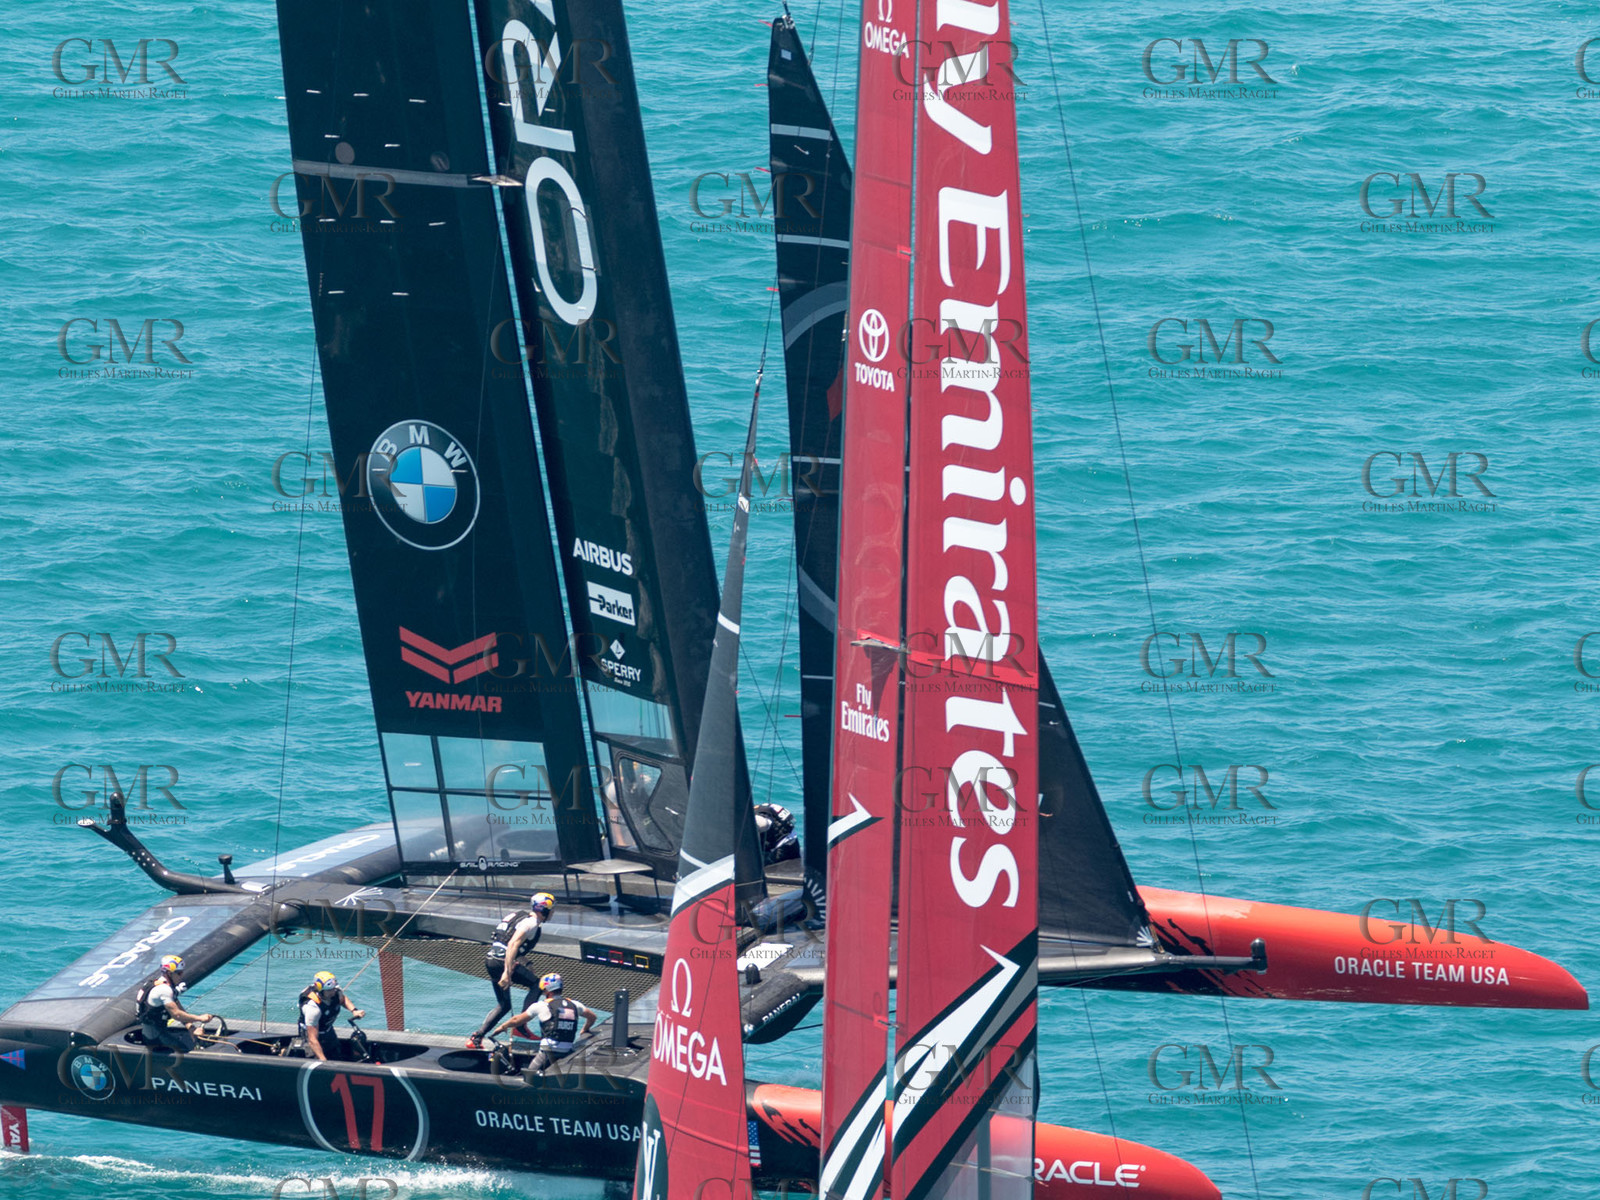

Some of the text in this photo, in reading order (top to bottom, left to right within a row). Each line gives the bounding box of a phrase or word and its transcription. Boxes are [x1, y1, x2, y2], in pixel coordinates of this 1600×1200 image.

[864, 21, 909, 58] OMEGA
[854, 362, 895, 392] TOYOTA
[376, 424, 468, 469] BMW
[573, 537, 633, 576] AIRBUS
[938, 186, 1028, 908] Emirates
[597, 594, 633, 621] Parker
[601, 658, 642, 682] SPERRY
[405, 691, 502, 713] YANMAR
[856, 683, 872, 710] Fly
[841, 700, 890, 742] Emirates
[78, 916, 191, 988] ORACLE
[1334, 956, 1510, 986] ORACLE TEAM USA
[653, 1012, 728, 1086] OMEGA
[151, 1077, 262, 1101] PANERAI
[330, 1073, 385, 1152] 17
[475, 1109, 545, 1133] ORACLE
[549, 1117, 602, 1139] TEAM
[9, 1123, 21, 1145] YA
